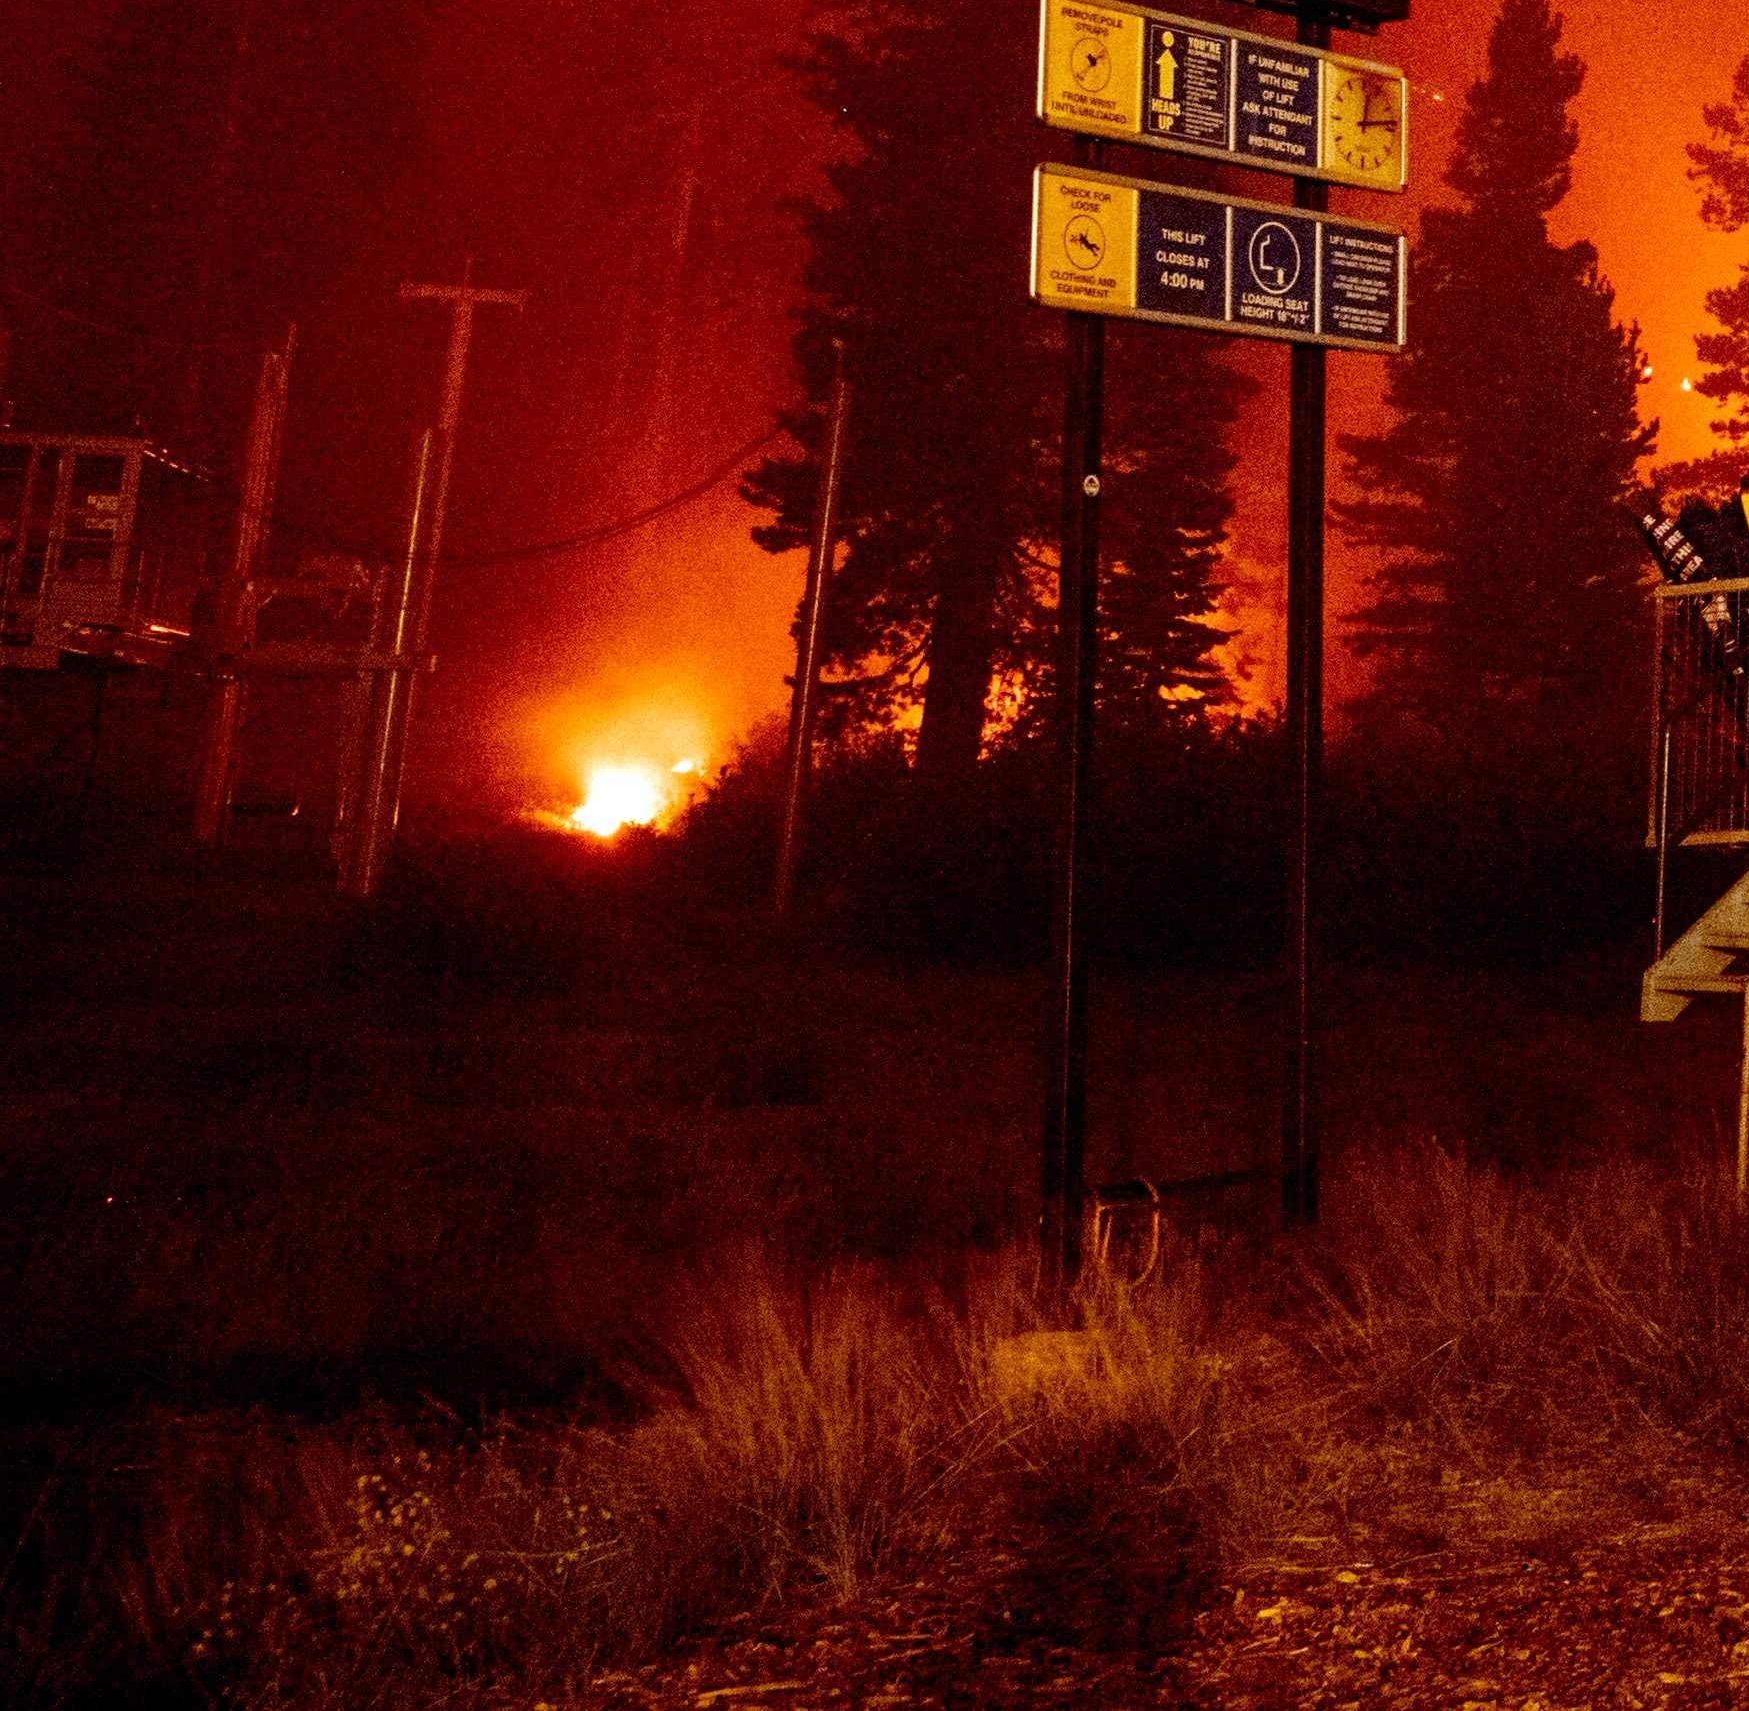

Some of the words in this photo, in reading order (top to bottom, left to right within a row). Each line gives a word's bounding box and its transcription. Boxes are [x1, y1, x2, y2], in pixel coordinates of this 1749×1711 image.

[1061, 7, 1099, 23] REMOVE
[1100, 15, 1123, 29] POLE
[1188, 37, 1221, 55] YOU'RE
[1248, 54, 1257, 65] IF
[1258, 56, 1309, 77] UNFAMILIAR
[1258, 72, 1280, 86] WITH
[1282, 78, 1299, 92] USE
[1062, 91, 1087, 103] FROM
[1090, 96, 1117, 109] WRIST
[1152, 97, 1181, 117] HEADS
[1262, 90, 1274, 101] OF
[1276, 93, 1295, 106] LIFT
[1051, 100, 1077, 114] UNTIL
[1079, 105, 1127, 125] UNLOADED
[1242, 101, 1260, 115] ASK
[1262, 106, 1313, 126] ATTENDANT
[1158, 114, 1174, 132] UP
[1268, 123, 1286, 137] FOR
[1248, 134, 1306, 156] INSTRUCTION
[1060, 184, 1091, 199] CHECK
[1094, 191, 1112, 203] FOR
[1071, 201, 1100, 213] LOOSE
[1161, 228, 1184, 243] THIS
[1185, 232, 1206, 246] LIFT
[1156, 250, 1195, 267] CLOSES
[1197, 257, 1210, 269] AT
[1050, 270, 1095, 285] CLOTHING
[1098, 277, 1117, 288] AND
[1160, 271, 1188, 288] 4:00
[1190, 278, 1205, 291] PM
[1057, 283, 1109, 299] EQUIPMENT
[1242, 292, 1284, 308] LOADING
[1285, 298, 1309, 312] SEAT
[1240, 305, 1274, 320] HEIGHT
